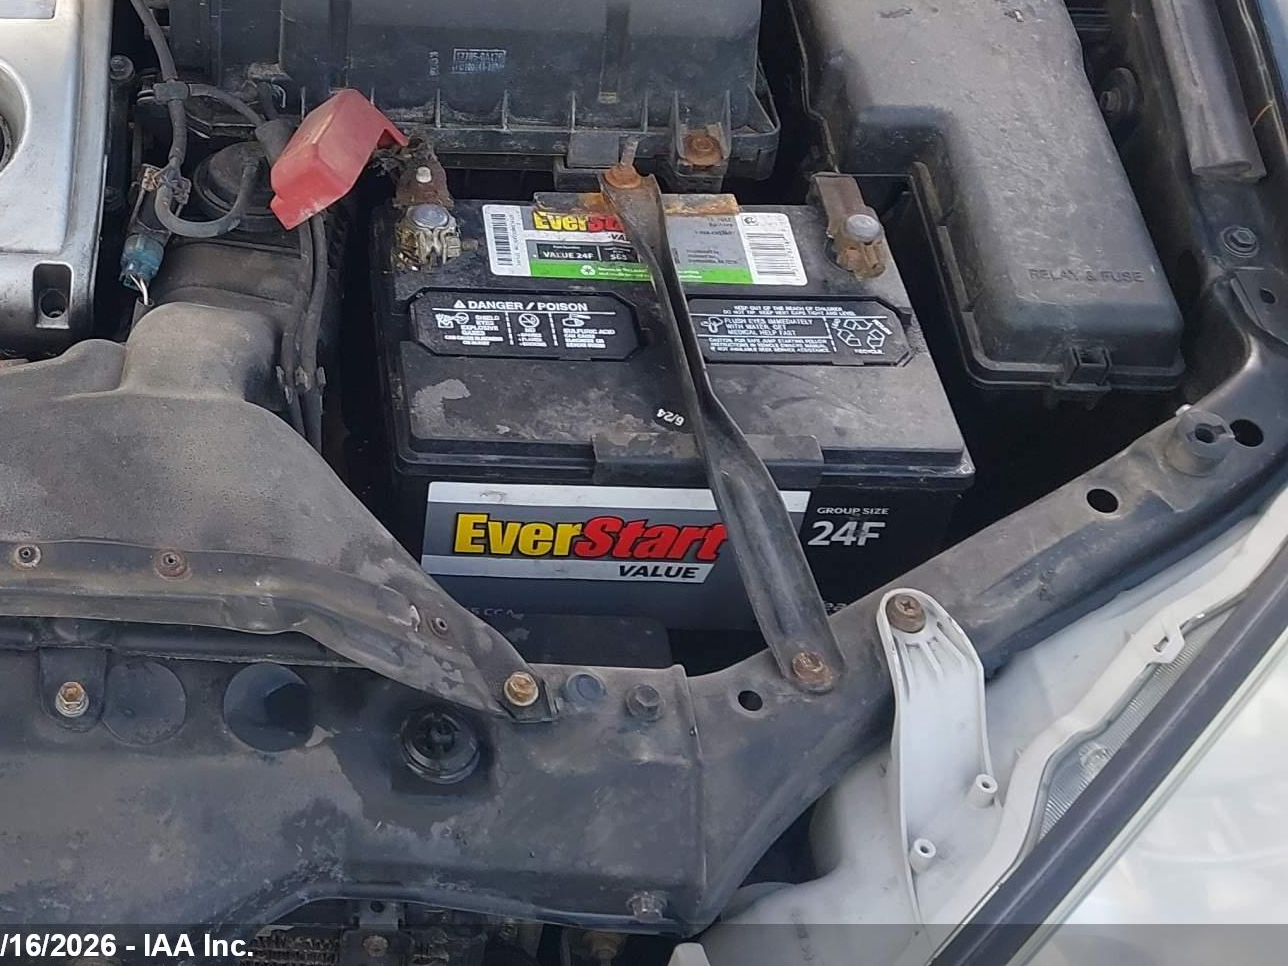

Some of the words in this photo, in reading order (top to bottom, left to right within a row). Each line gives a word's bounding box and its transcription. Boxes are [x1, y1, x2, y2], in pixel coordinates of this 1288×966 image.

[543, 251, 576, 259] VALUE
[576, 251, 594, 260] 24F
[1028, 268, 1080, 282] RELAY
[1100, 270, 1145, 283] FUSE
[468, 301, 524, 310] DANGER
[537, 303, 588, 312] POISON
[656, 408, 685, 426] 6/24
[817, 506, 860, 515] GROUP
[862, 507, 890, 516] SIZE
[452, 511, 728, 562] EverStart
[808, 520, 887, 547] 24F
[618, 565, 700, 579] VALUE
